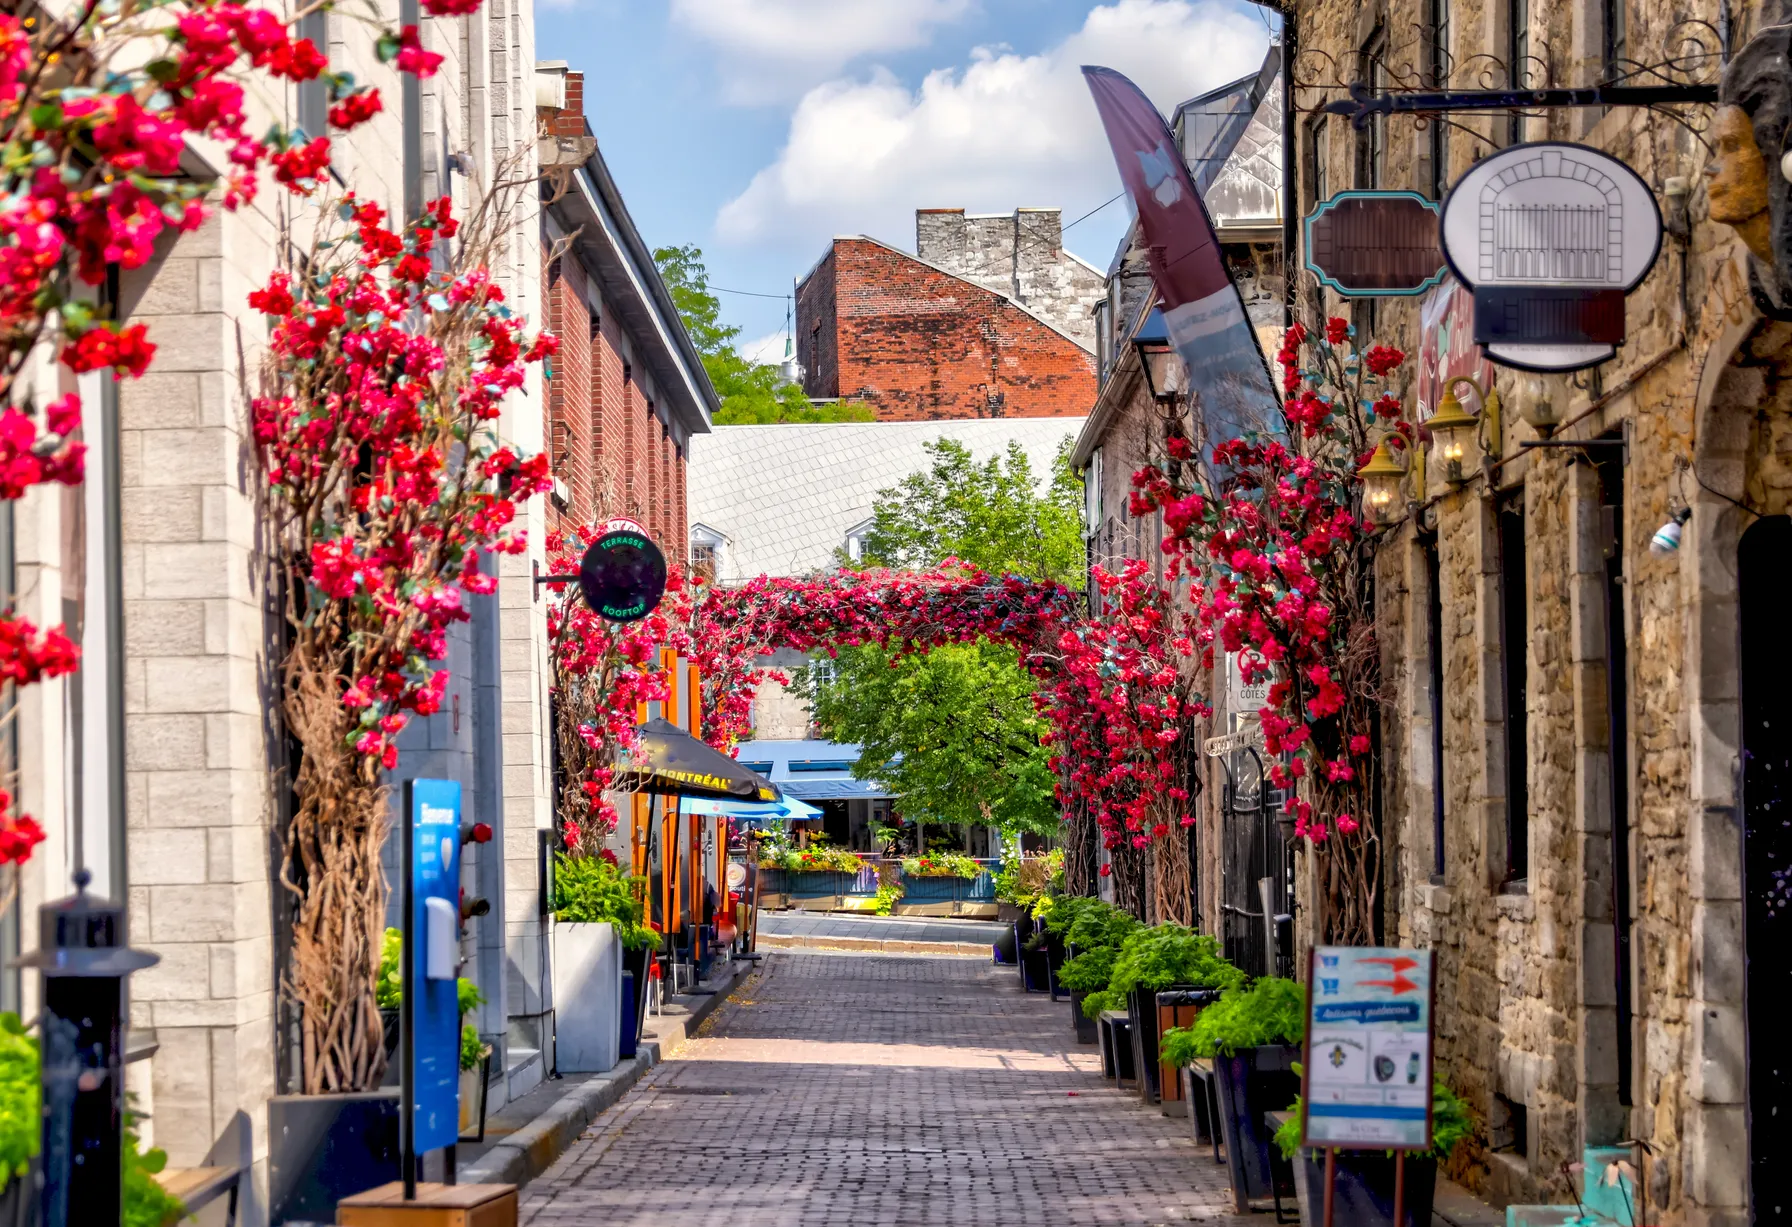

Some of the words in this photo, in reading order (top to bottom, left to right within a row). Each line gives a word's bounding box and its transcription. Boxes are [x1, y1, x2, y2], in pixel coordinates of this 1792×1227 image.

[601, 537, 644, 550] TERRASSE
[602, 604, 645, 617] ROOFTOP
[1240, 689, 1266, 699] CÔTES
